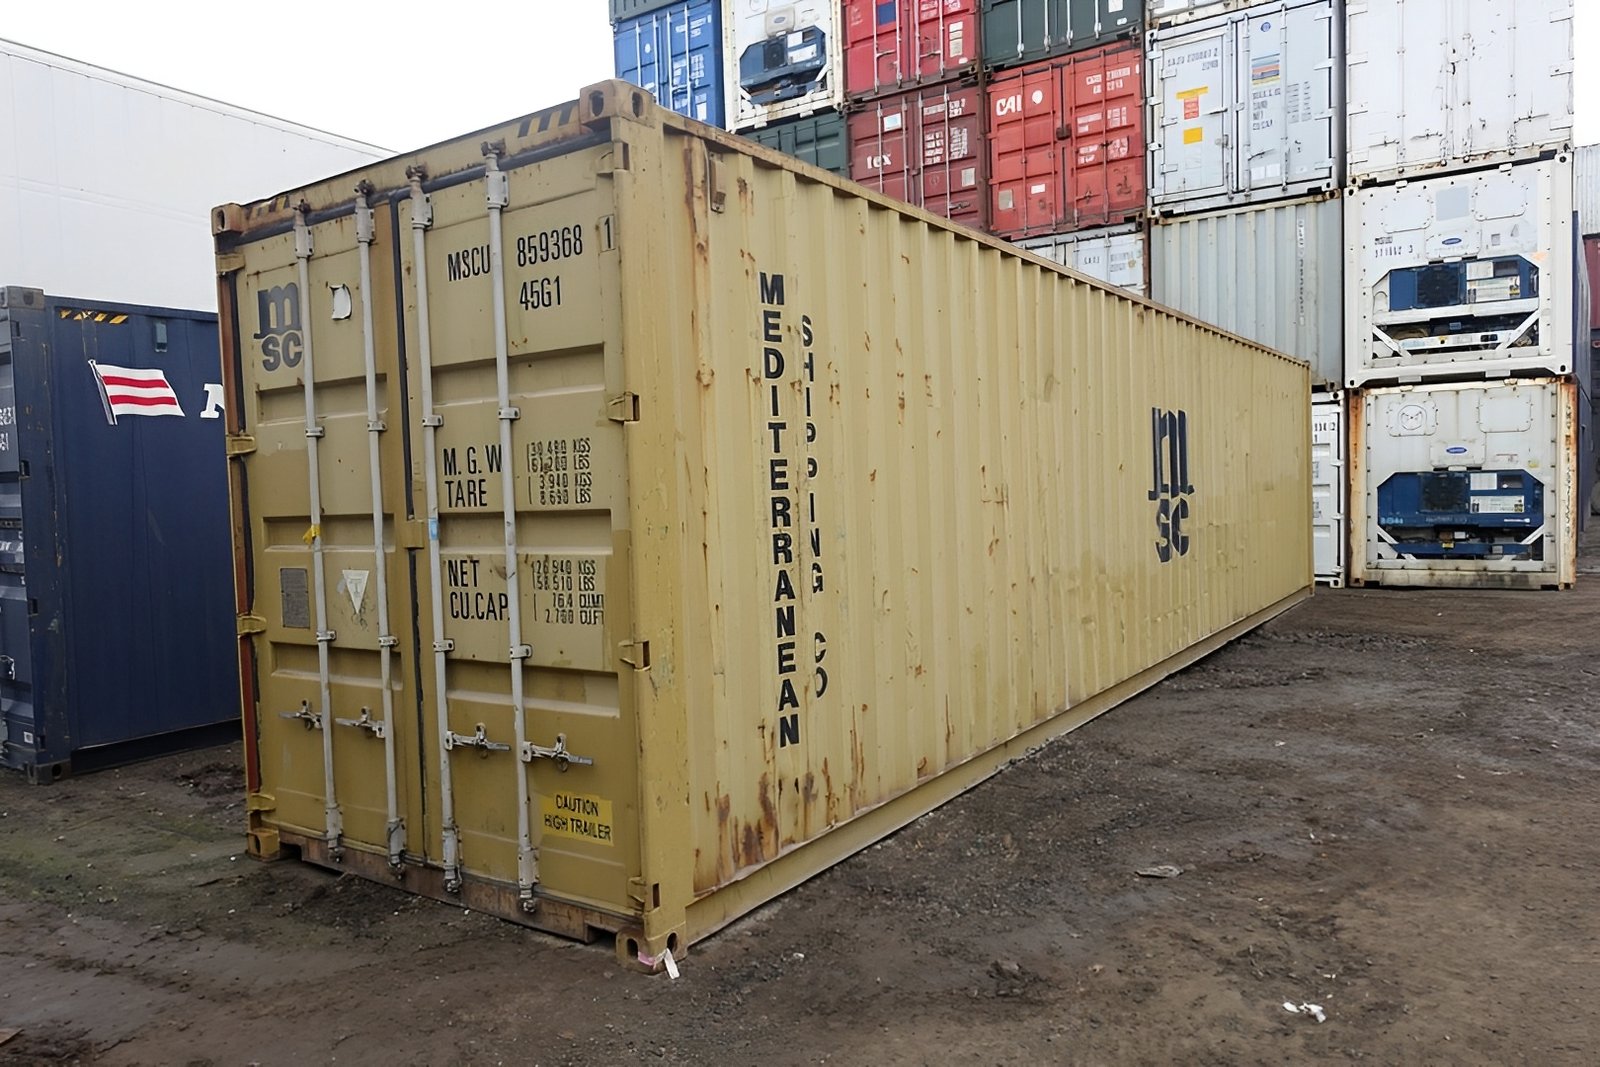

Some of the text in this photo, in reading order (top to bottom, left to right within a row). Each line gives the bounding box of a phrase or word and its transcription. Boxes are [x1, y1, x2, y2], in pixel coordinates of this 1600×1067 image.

[447, 217, 613, 282] MSCU 859368 1
[519, 275, 561, 311] 45G1
[445, 479, 488, 508] TARE
[758, 271, 801, 748] MEDITERRANEAN
[448, 559, 480, 588] NET
[555, 794, 599, 817] CAUTION
[569, 817, 611, 842] TRAILER
